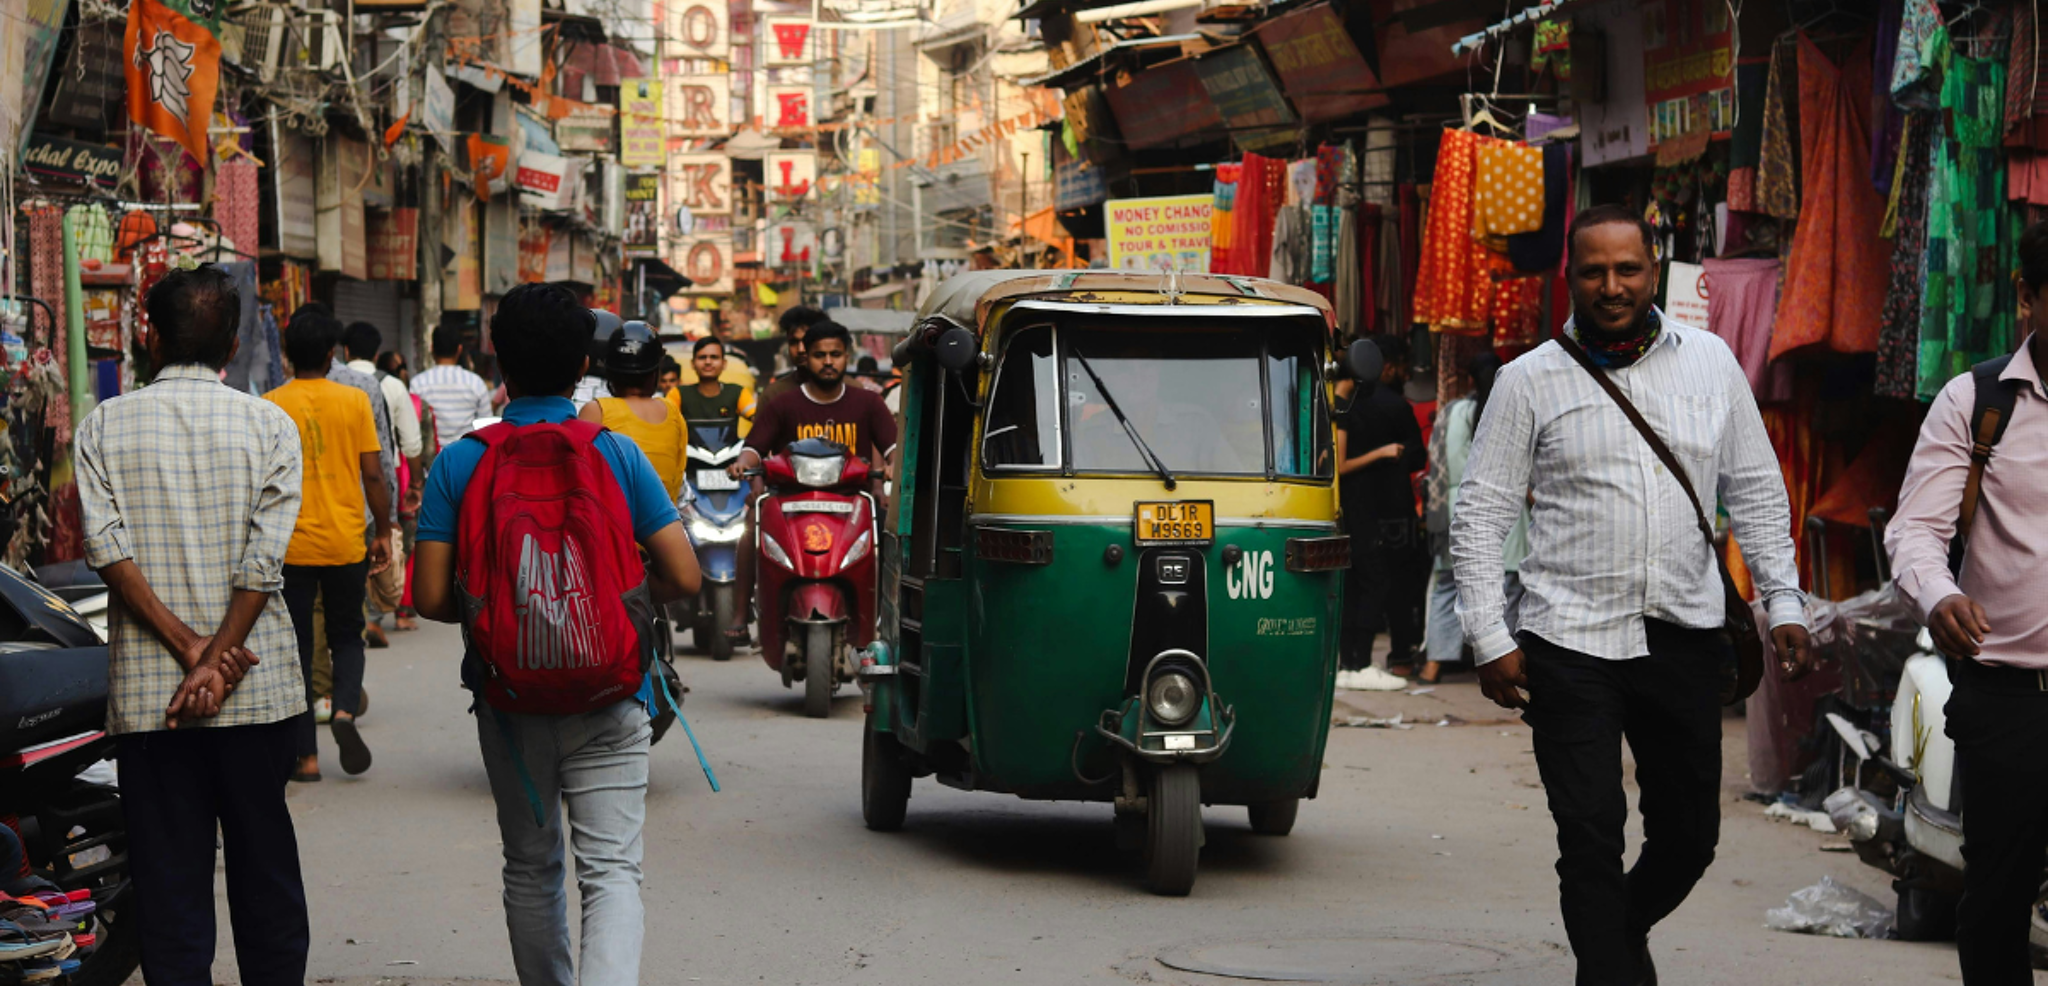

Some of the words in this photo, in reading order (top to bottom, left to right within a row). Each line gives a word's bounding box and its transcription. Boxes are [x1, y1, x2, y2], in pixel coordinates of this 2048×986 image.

[1113, 207, 1160, 223] MONEY
[1164, 204, 1214, 220] CHANG
[1125, 226, 1143, 237] NO
[1118, 241, 1153, 252] TOUR
[1158, 240, 1167, 250] &
[1157, 505, 1198, 521] DL1R
[1163, 566, 1183, 578] RE
[1226, 551, 1274, 599] CNG
